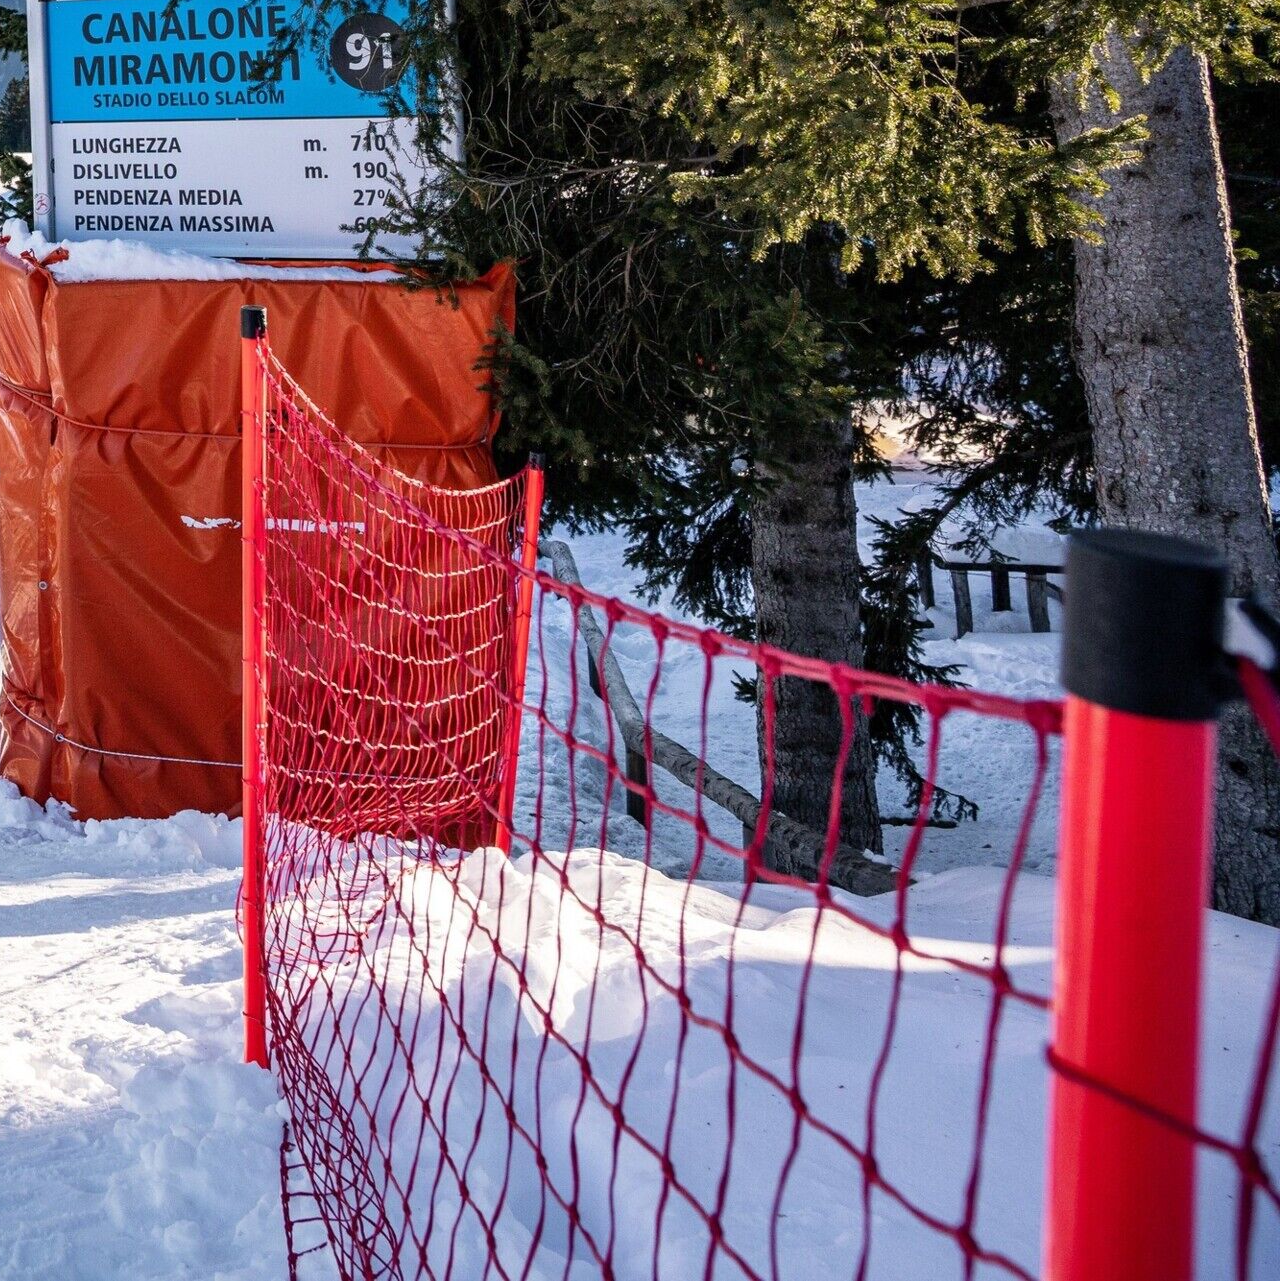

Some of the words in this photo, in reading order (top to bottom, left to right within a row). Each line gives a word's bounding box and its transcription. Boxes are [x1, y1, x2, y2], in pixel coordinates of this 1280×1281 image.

[81, 5, 287, 45] CANALONE
[345, 32, 393, 71] 91
[93, 92, 152, 108] STADIO
[157, 91, 210, 107] DELLO
[215, 89, 285, 106] SLALOM
[72, 137, 182, 154] LUNGHEZZA
[303, 139, 327, 152] m.
[350, 134, 386, 151] 710
[73, 164, 178, 180] DISLIVELLO
[304, 166, 328, 179] m.
[352, 162, 388, 179] 190
[74, 189, 173, 206] PENDENZA
[178, 189, 243, 206] MEDIA
[74, 215, 174, 231] PENDENZA
[179, 216, 275, 233] MASSIMA
